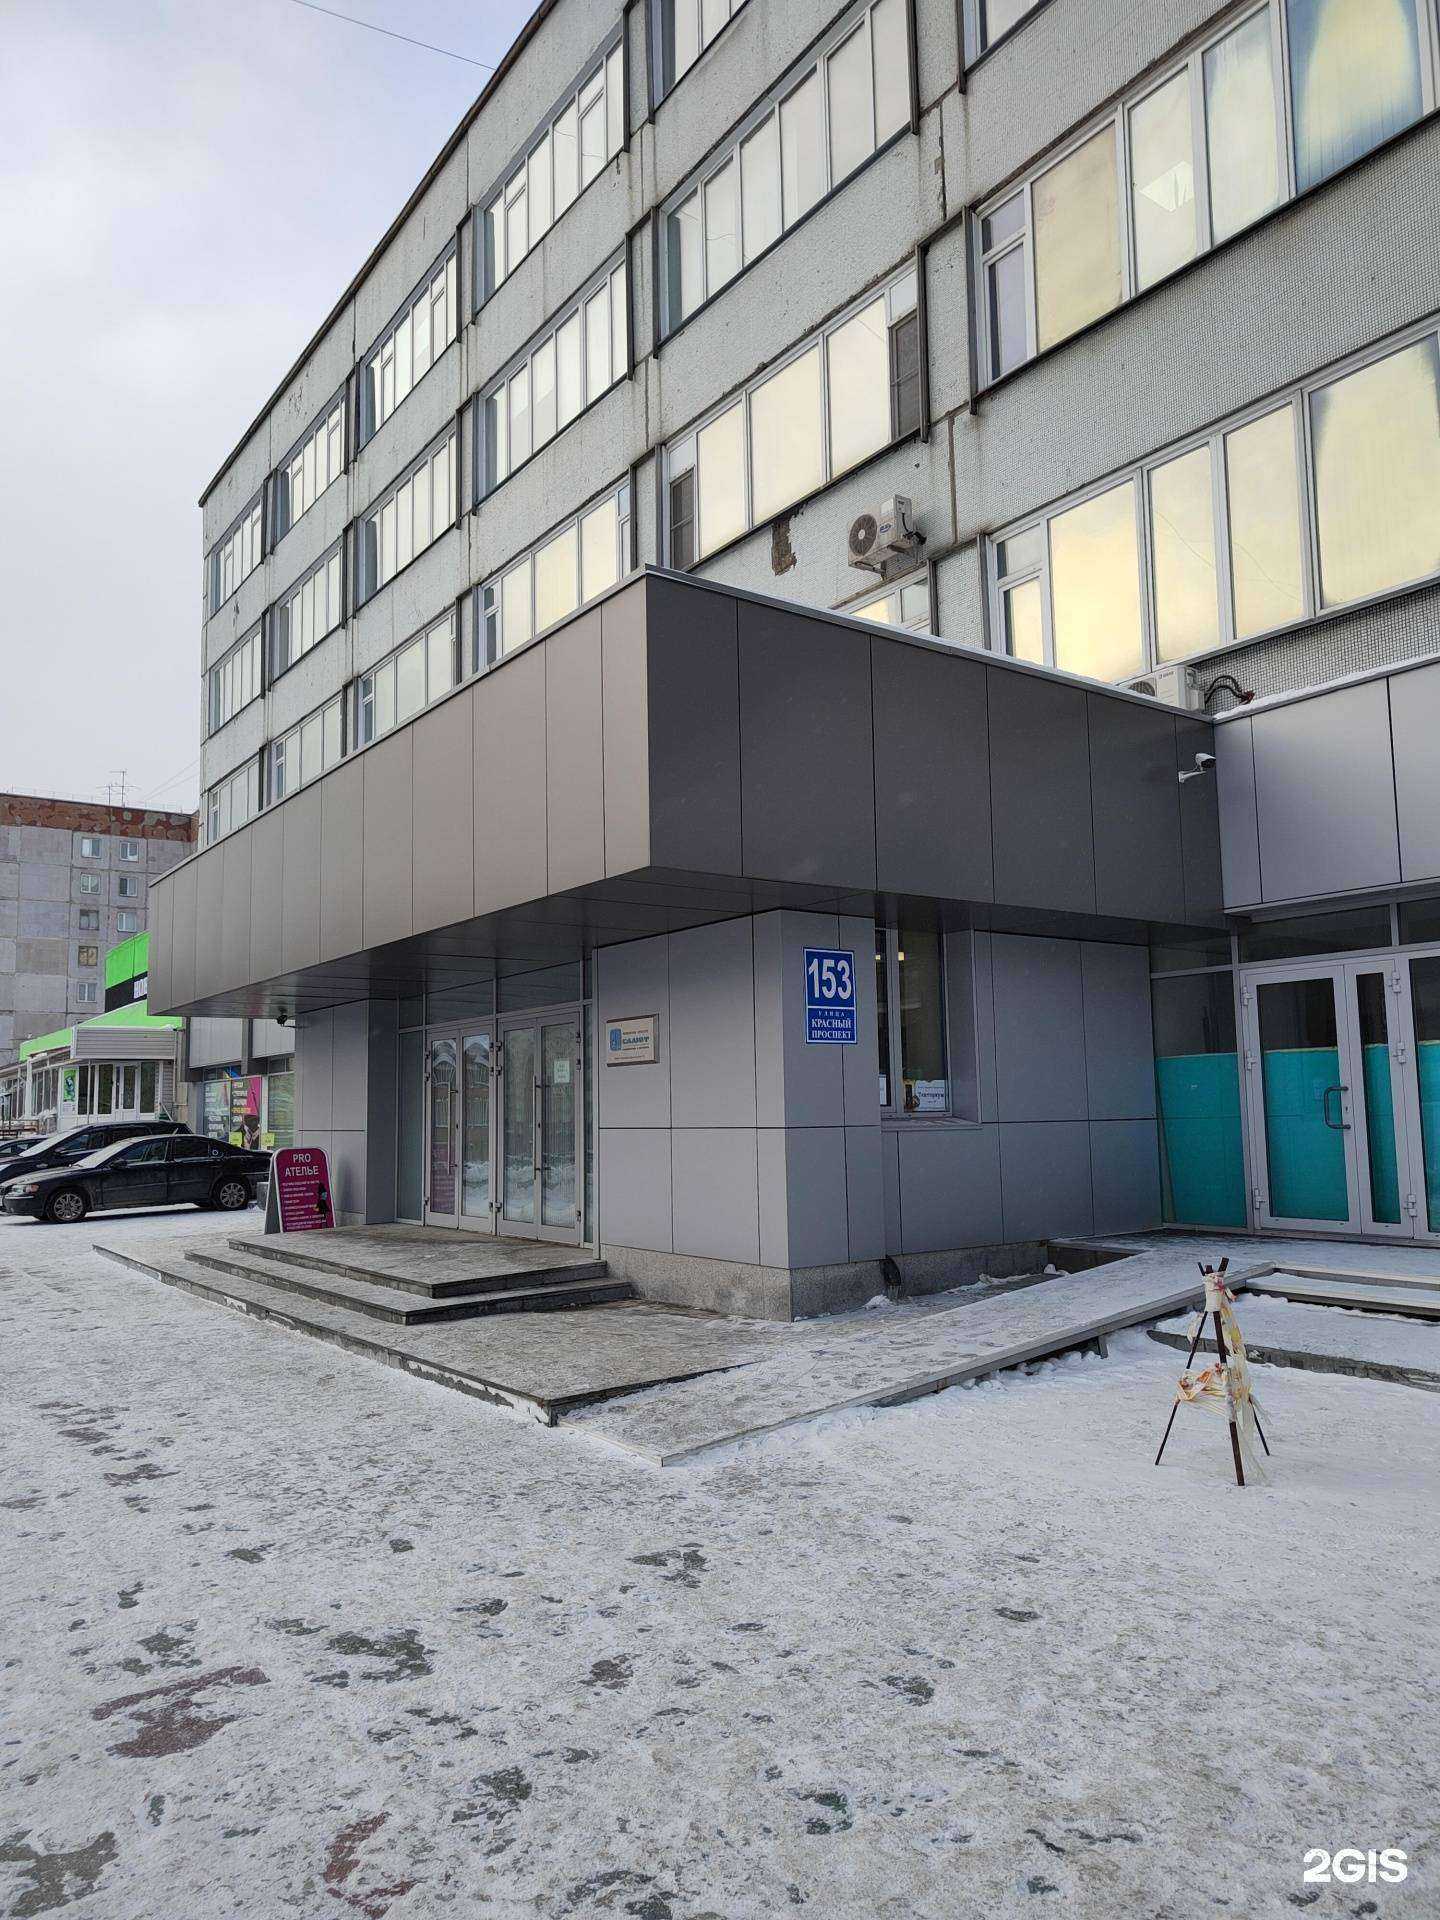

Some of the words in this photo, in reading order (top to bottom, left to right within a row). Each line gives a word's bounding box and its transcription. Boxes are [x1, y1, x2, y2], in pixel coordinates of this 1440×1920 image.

[808, 958, 852, 999] 153
[811, 1018, 852, 1029] КРАСНЫЙ
[811, 1030, 852, 1039] ПРОСПЕКТ
[292, 1153, 311, 1163] PRO
[284, 1165, 319, 1177] АТЕЛЬЕ
